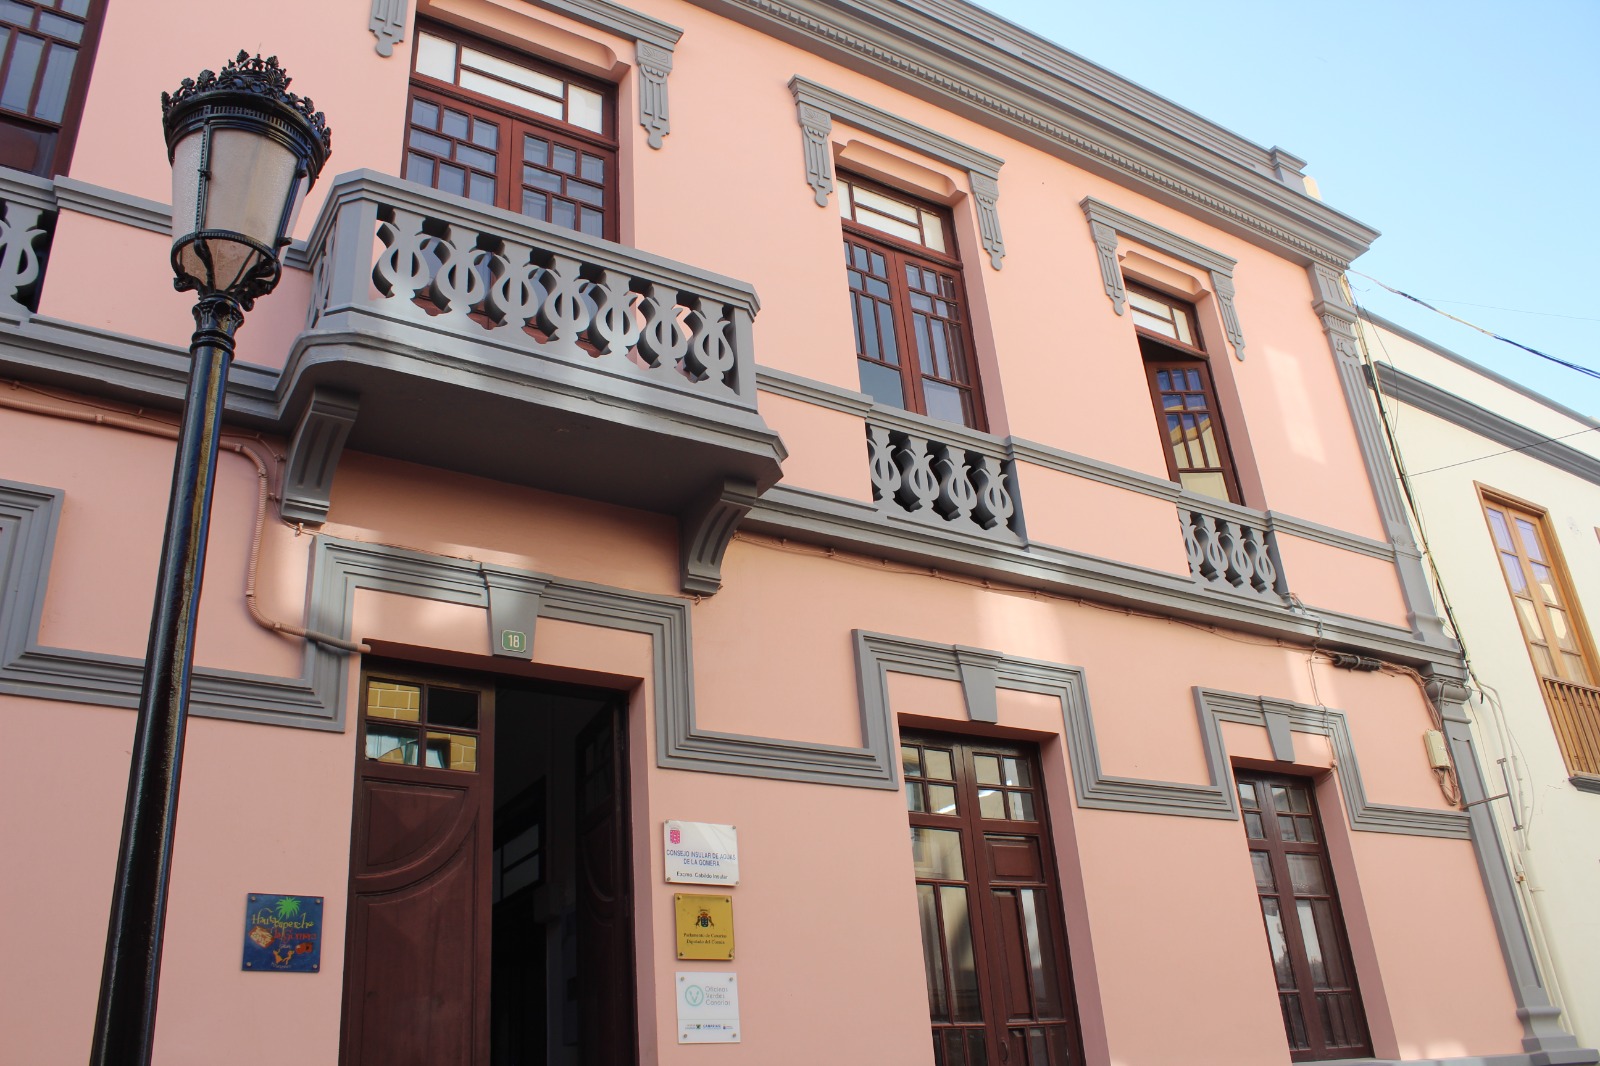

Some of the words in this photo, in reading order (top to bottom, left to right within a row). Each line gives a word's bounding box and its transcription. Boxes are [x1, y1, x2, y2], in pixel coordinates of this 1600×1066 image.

[508, 634, 520, 648] 18
[666, 849, 690, 858] CONSEJO
[691, 851, 711, 859] INSULAR
[712, 852, 719, 860] DE
[698, 859, 720, 867] GOMERA
